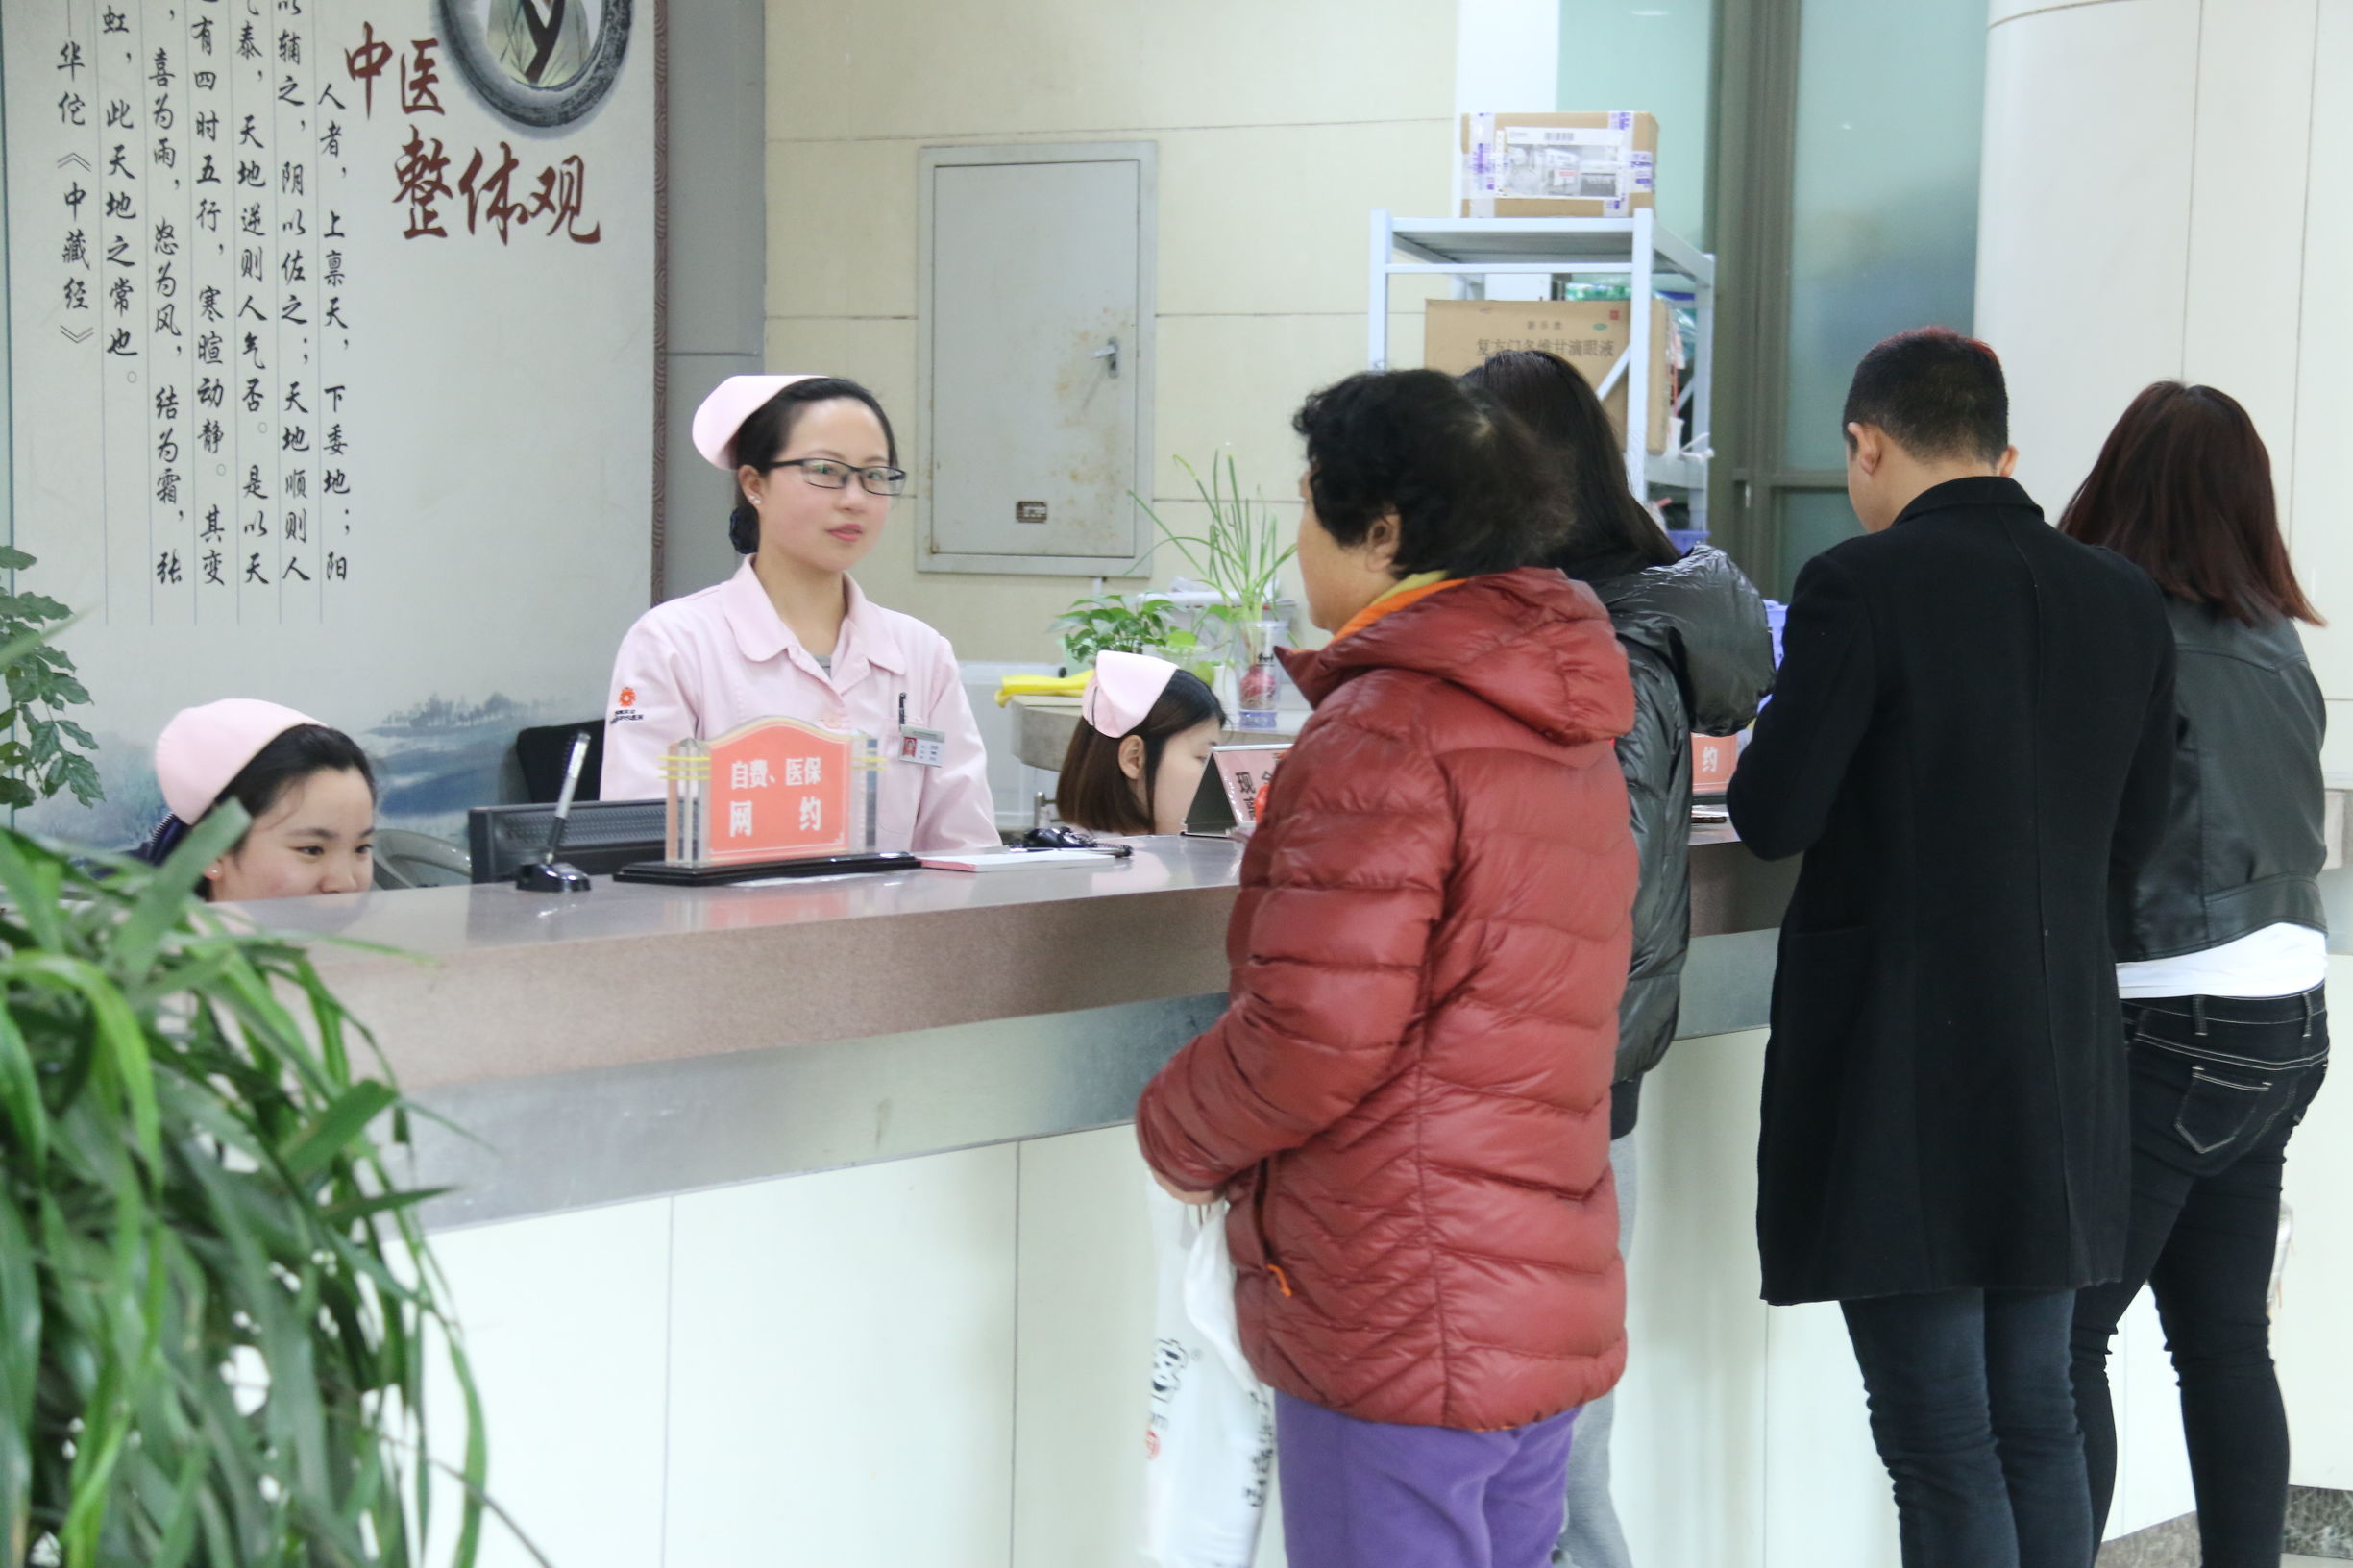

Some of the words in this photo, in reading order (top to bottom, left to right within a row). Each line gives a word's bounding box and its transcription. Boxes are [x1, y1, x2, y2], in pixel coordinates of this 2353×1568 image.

[102, 6, 138, 384] 虹，此天地之常也。
[344, 21, 445, 120] 中医
[392, 124, 601, 247] 整体观
[190, 0, 227, 587] 有四时五行，寒暄动静。其变
[318, 83, 352, 581] 人者，上禀天，下委地；阳
[730, 756, 822, 791] 自费、医保
